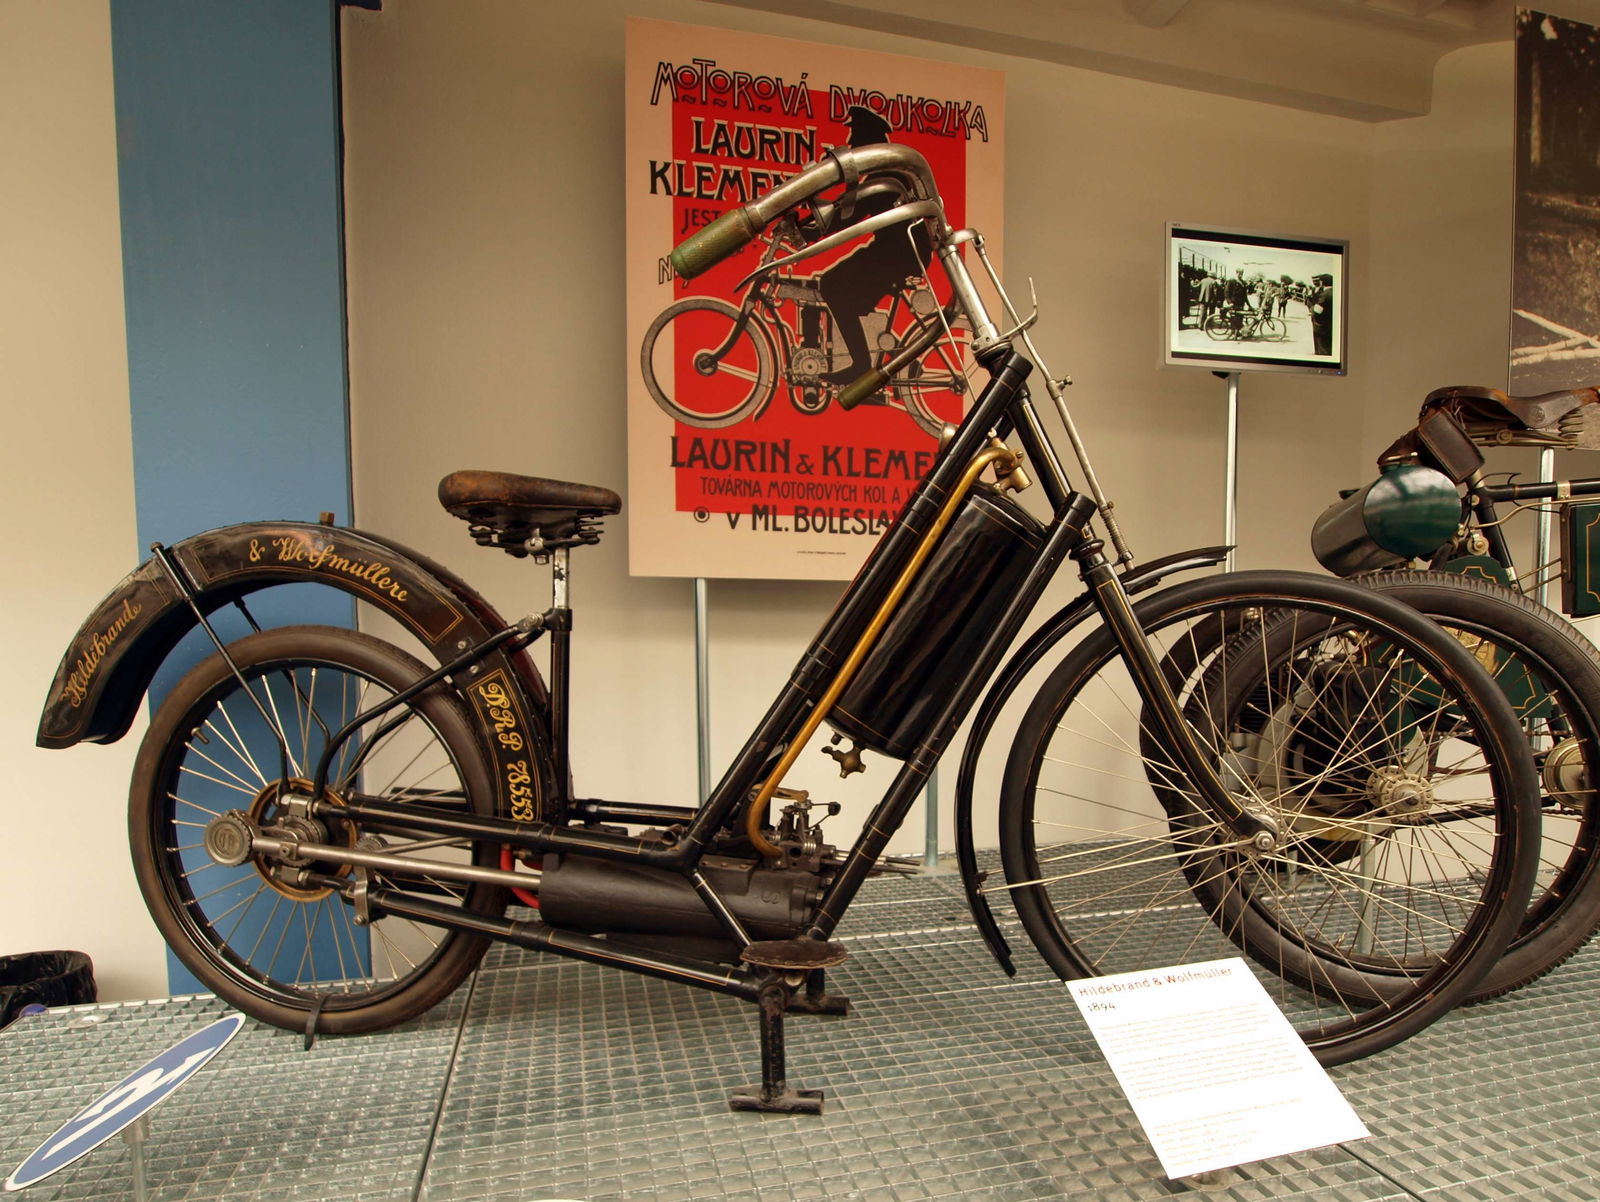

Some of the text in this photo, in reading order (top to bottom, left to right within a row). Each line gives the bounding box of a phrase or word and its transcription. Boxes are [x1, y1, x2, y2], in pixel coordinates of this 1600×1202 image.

[650, 58, 813, 119] MOTOROVÁ
[691, 116, 817, 164] LAURIN
[670, 435, 940, 481] LAURIN & KLEME
[700, 475, 763, 498] TOVÁRNA
[767, 480, 857, 503] MOTOROVÝCH
[863, 485, 888, 504] KOL
[891, 487, 900, 505] A
[751, 504, 789, 532] ML.
[249, 539, 266, 562] &
[507, 759, 535, 822] 78553
[1078, 977, 1151, 997] Hildebrand
[1153, 976, 1163, 987] &
